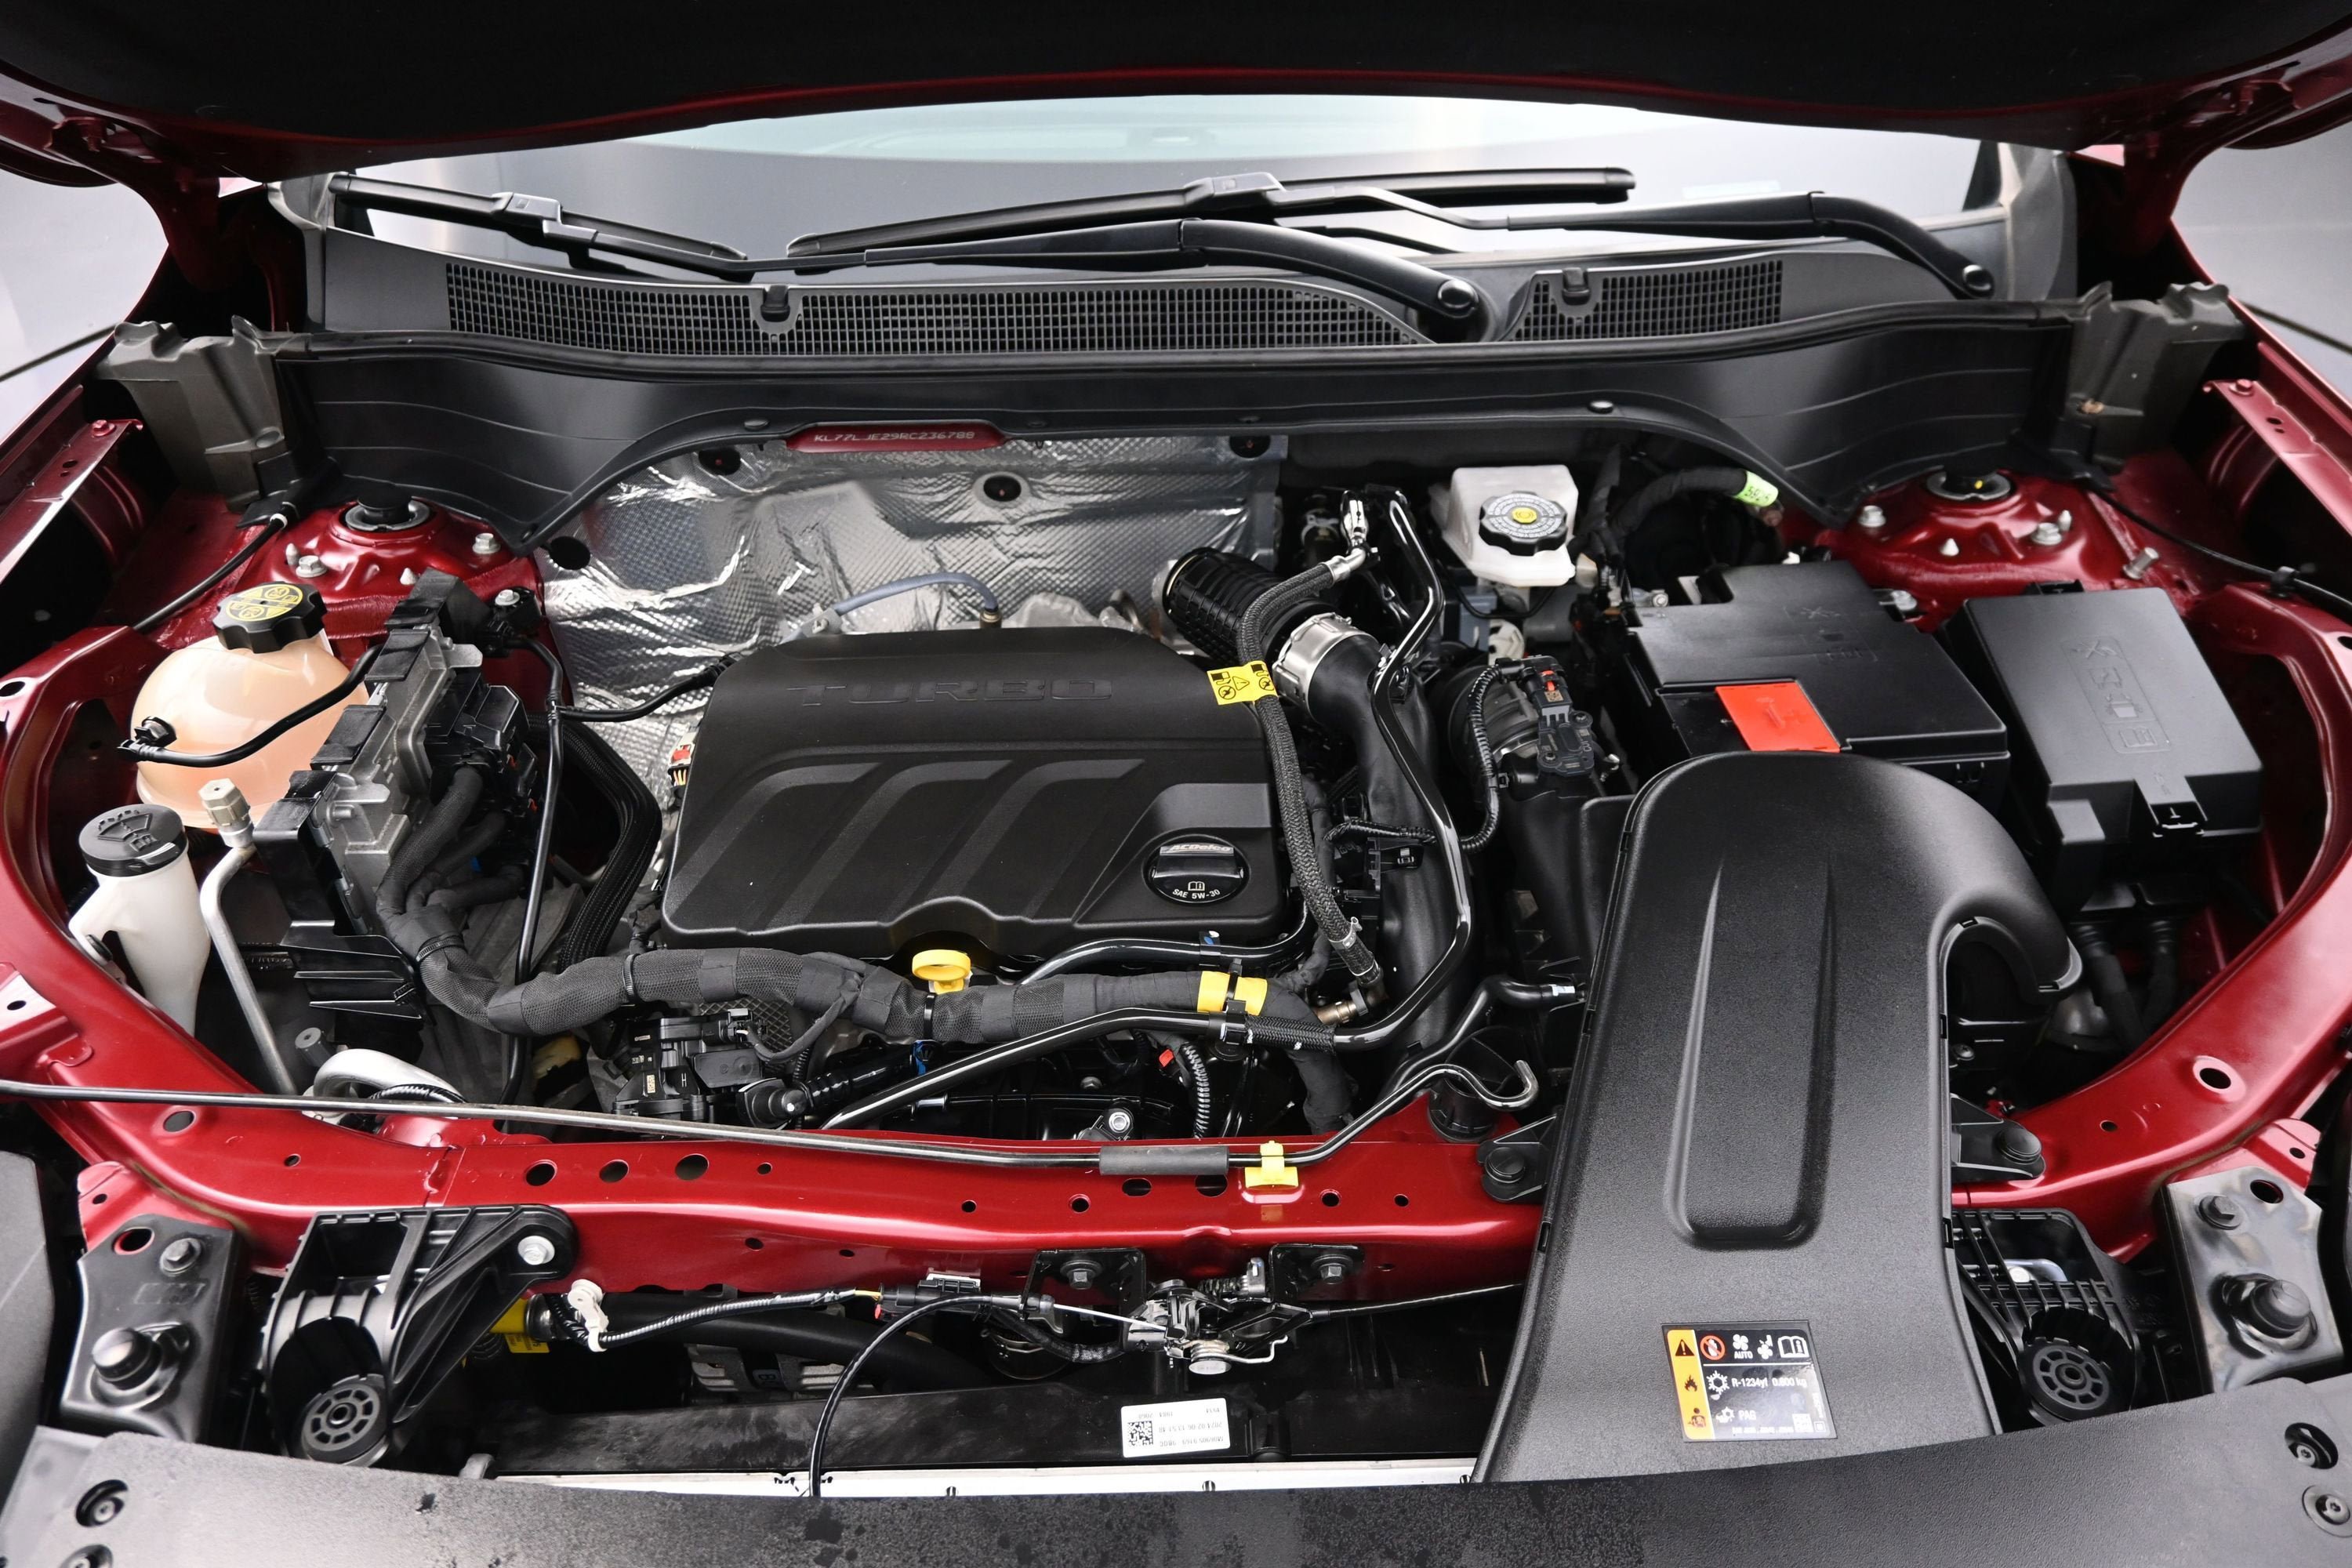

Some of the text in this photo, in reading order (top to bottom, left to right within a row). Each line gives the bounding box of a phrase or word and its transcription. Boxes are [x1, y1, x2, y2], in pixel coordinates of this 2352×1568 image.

[814, 431, 975, 442] KL77LJE29RC236788
[786, 679, 1112, 706] TURBO
[1172, 888, 1221, 899] SAE 5W-30
[1733, 1351, 1753, 1359] AUTO
[1738, 1410, 1757, 1421] PAG
